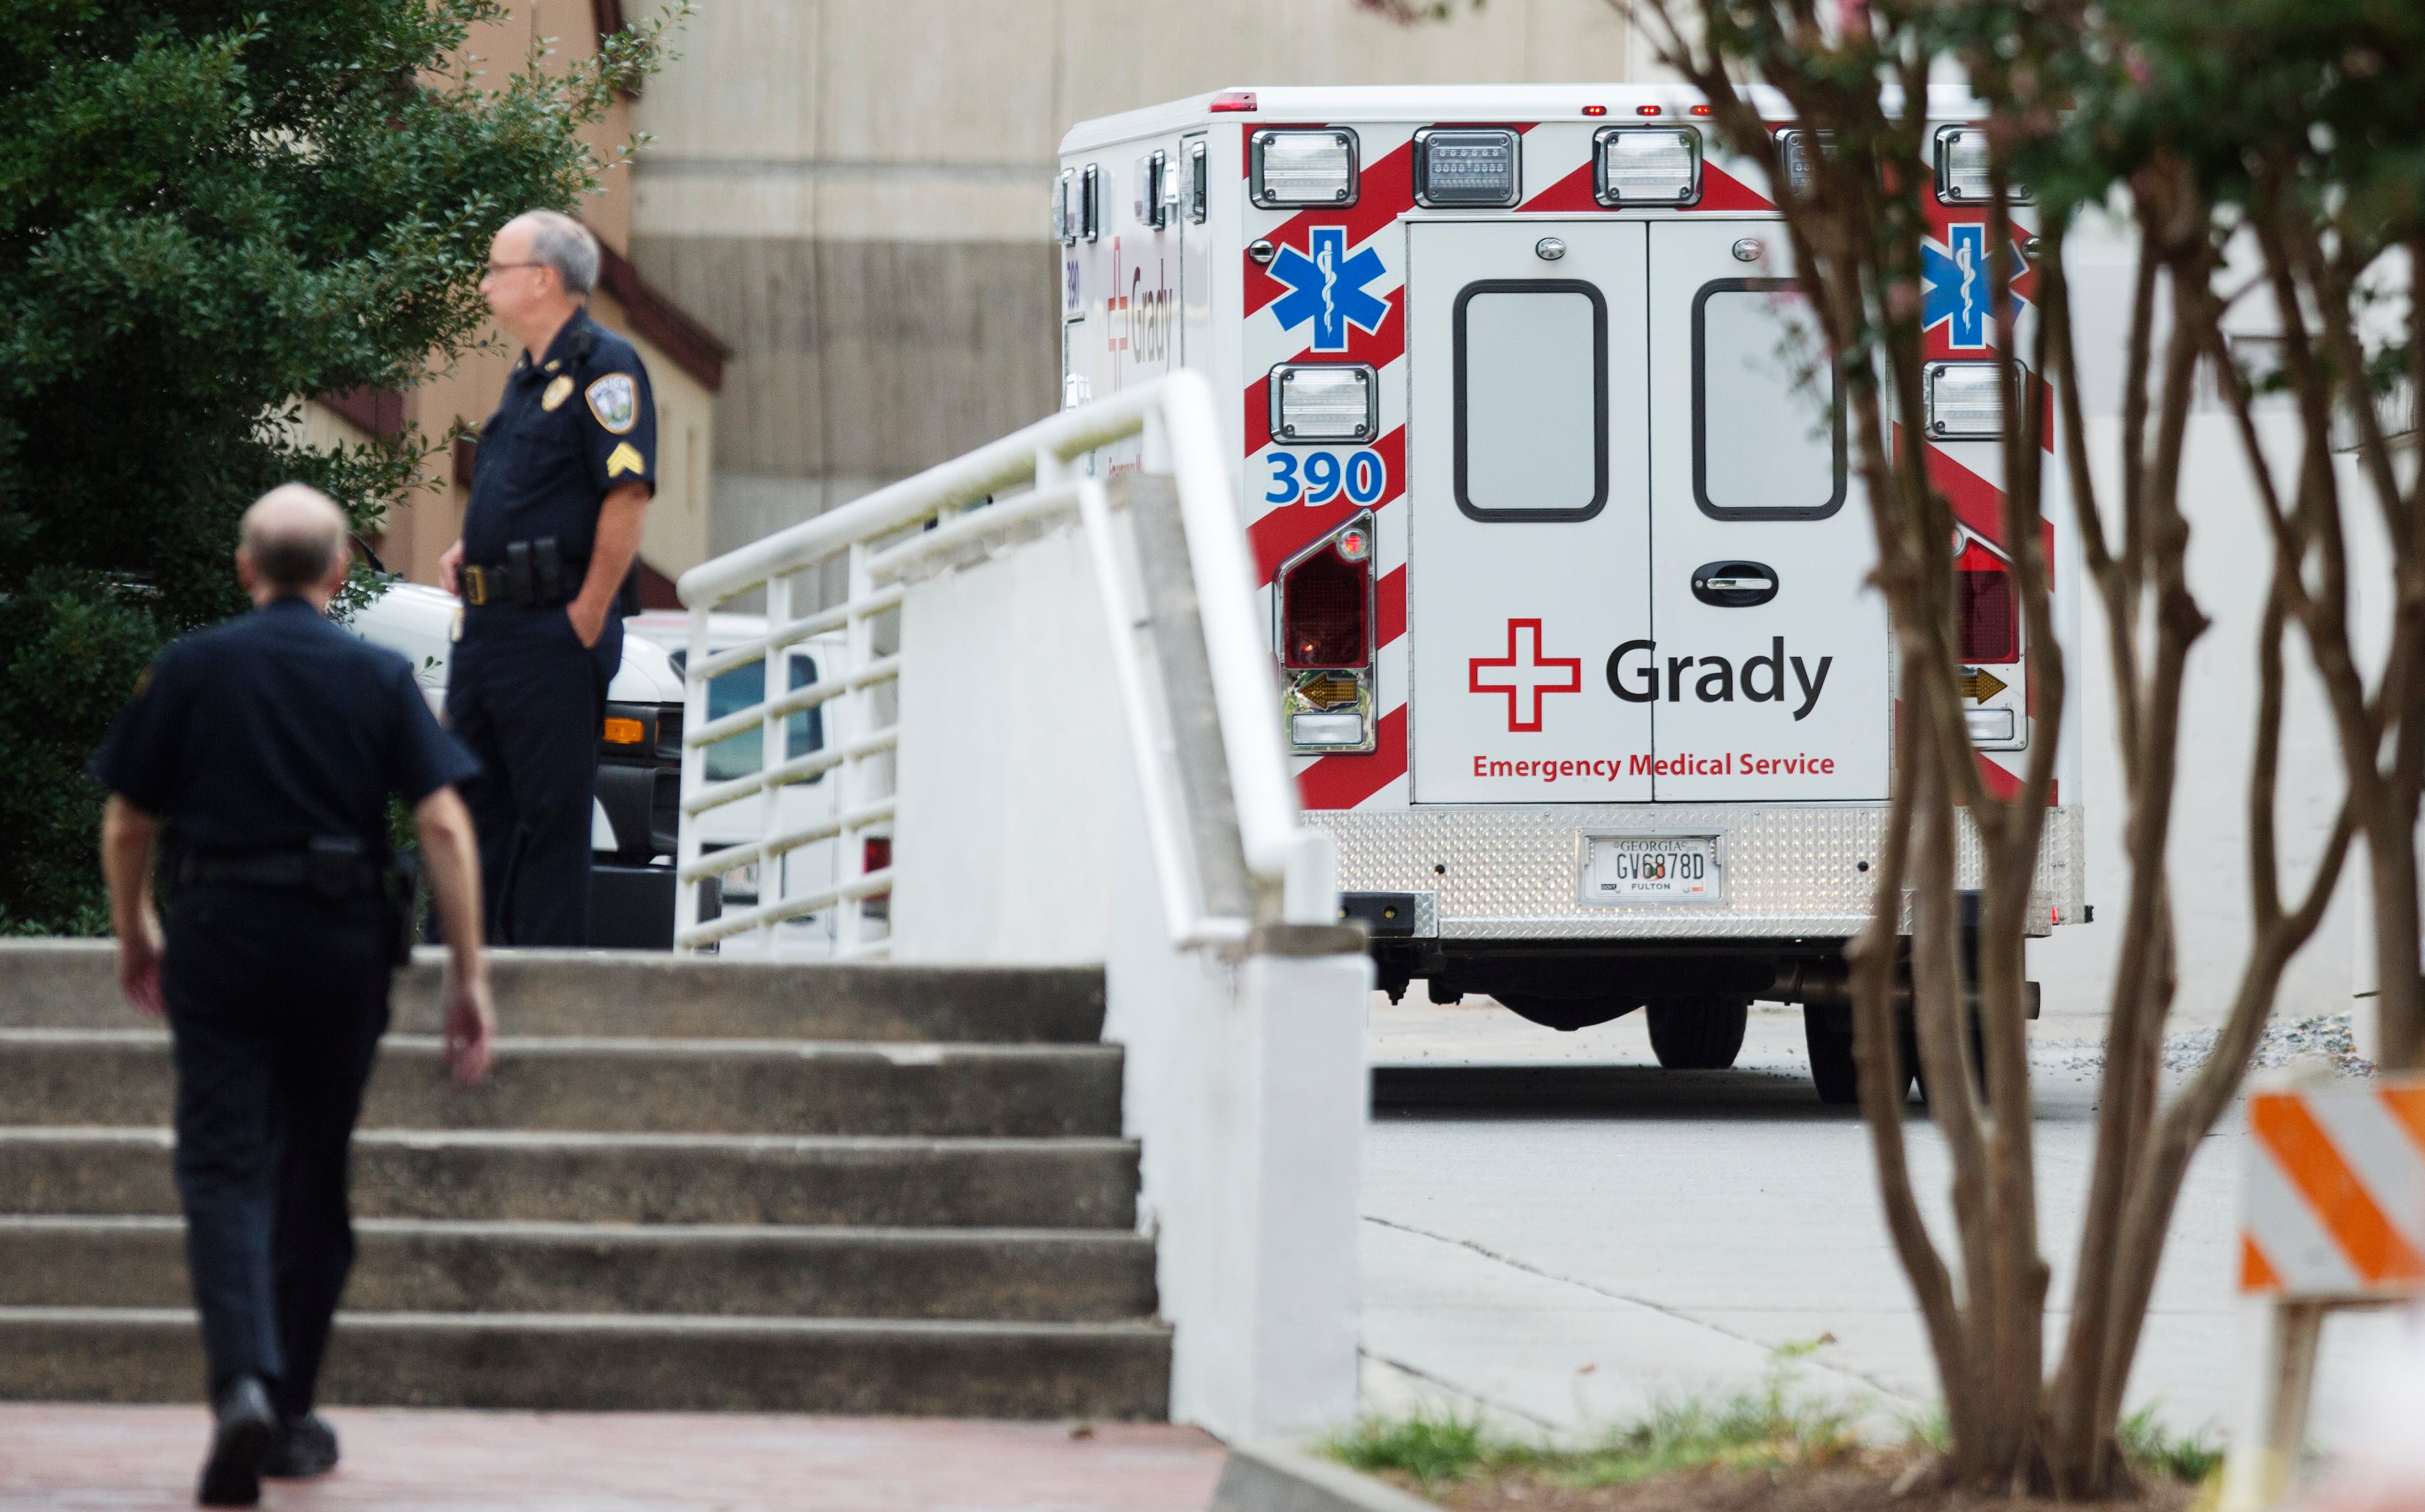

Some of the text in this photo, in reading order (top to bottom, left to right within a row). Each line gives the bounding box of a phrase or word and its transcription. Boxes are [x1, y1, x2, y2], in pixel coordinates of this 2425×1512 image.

[1067, 259, 1079, 309] 390
[1132, 258, 1173, 374] Grady
[1265, 451, 1383, 506] 390
[1605, 635, 1833, 722] Grady
[1473, 751, 1835, 783] Emergency Medical Service
[1617, 853, 1704, 879] GV6878D
[1631, 883, 1671, 891] FULTON
